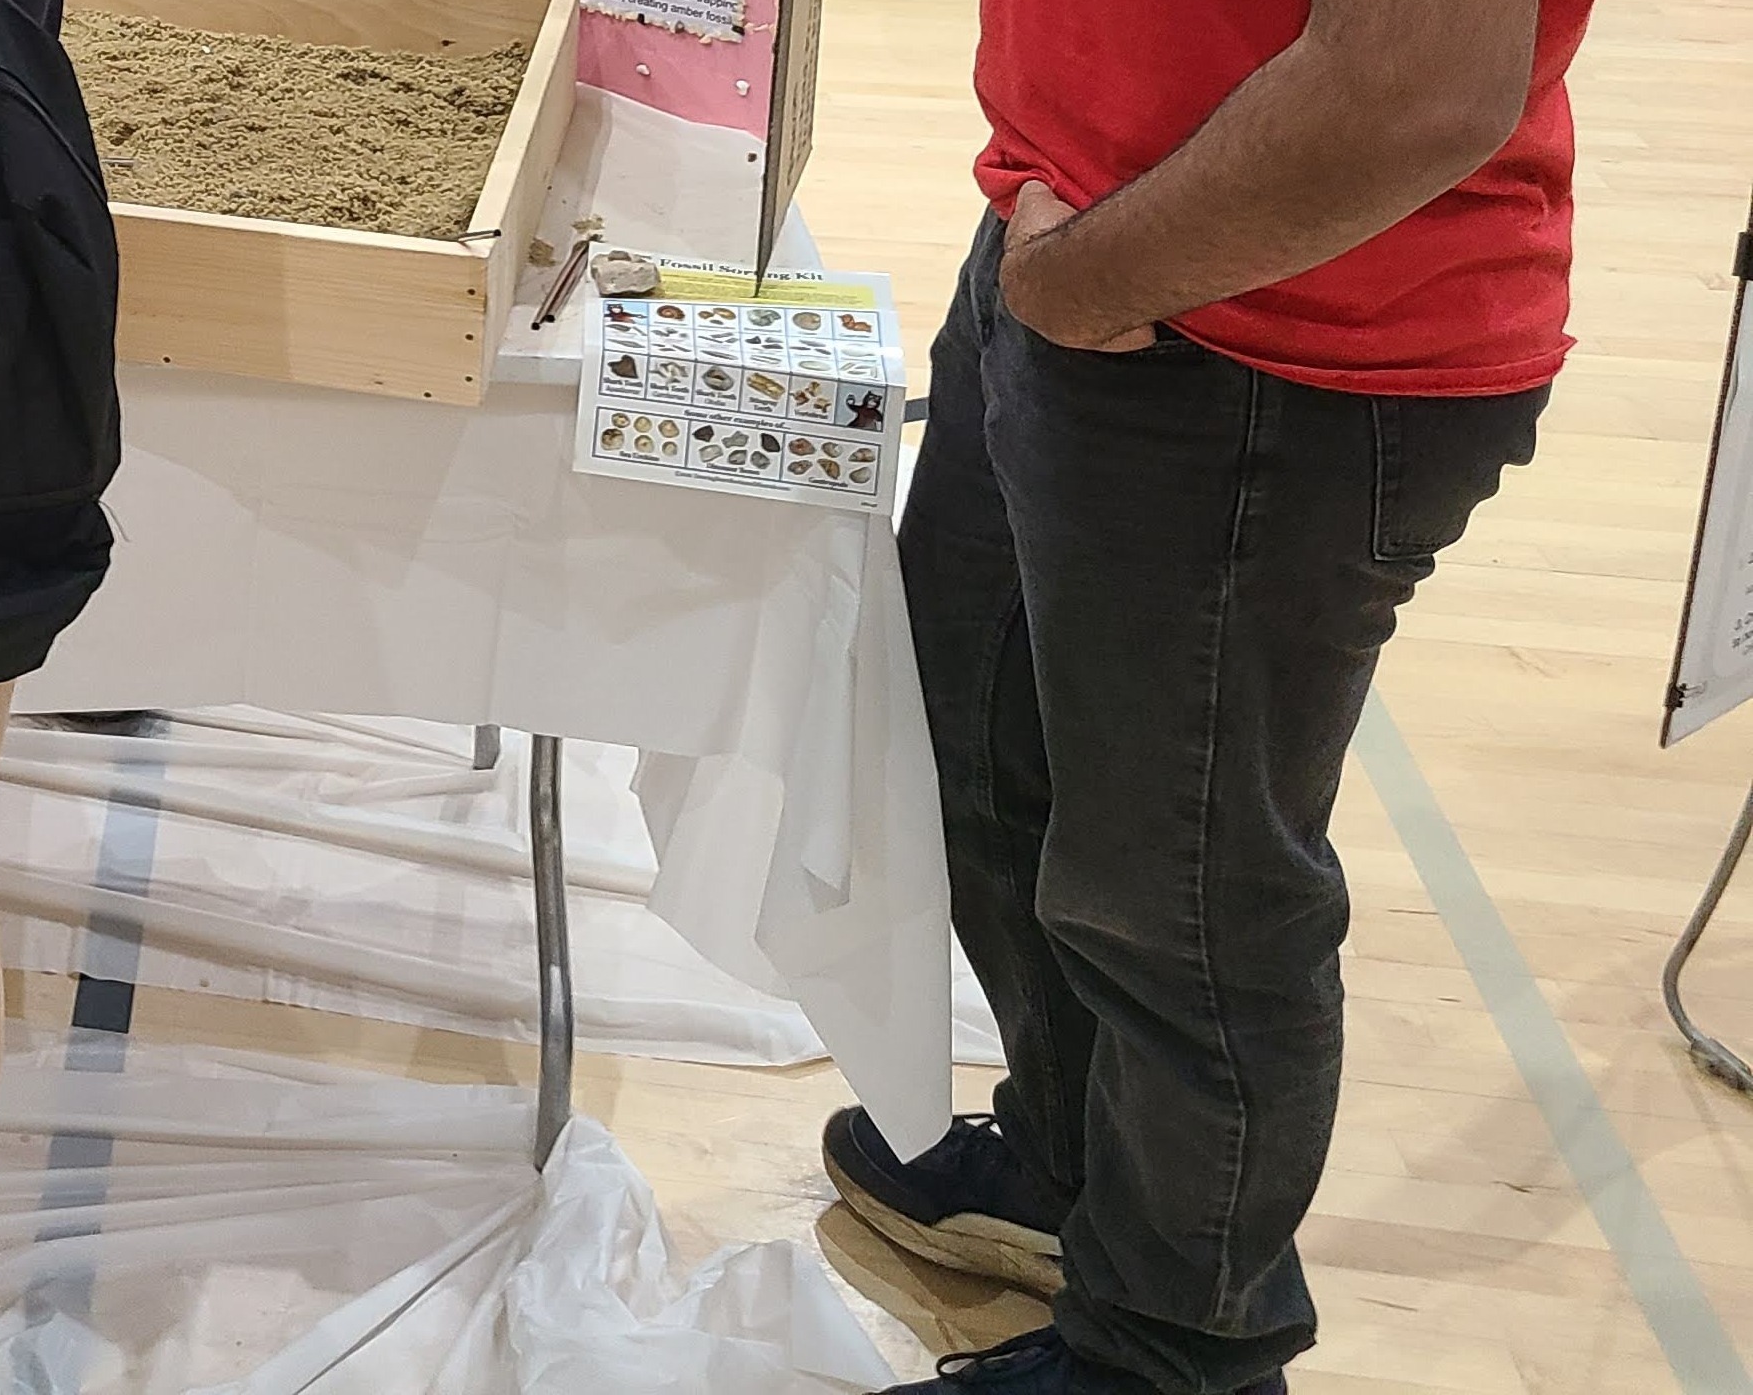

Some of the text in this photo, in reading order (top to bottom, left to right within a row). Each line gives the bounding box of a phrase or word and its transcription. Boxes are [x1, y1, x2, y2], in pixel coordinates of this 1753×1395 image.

[671, 5, 704, 18] amber
[660, 258, 824, 281] Fossil Sorng Kit
